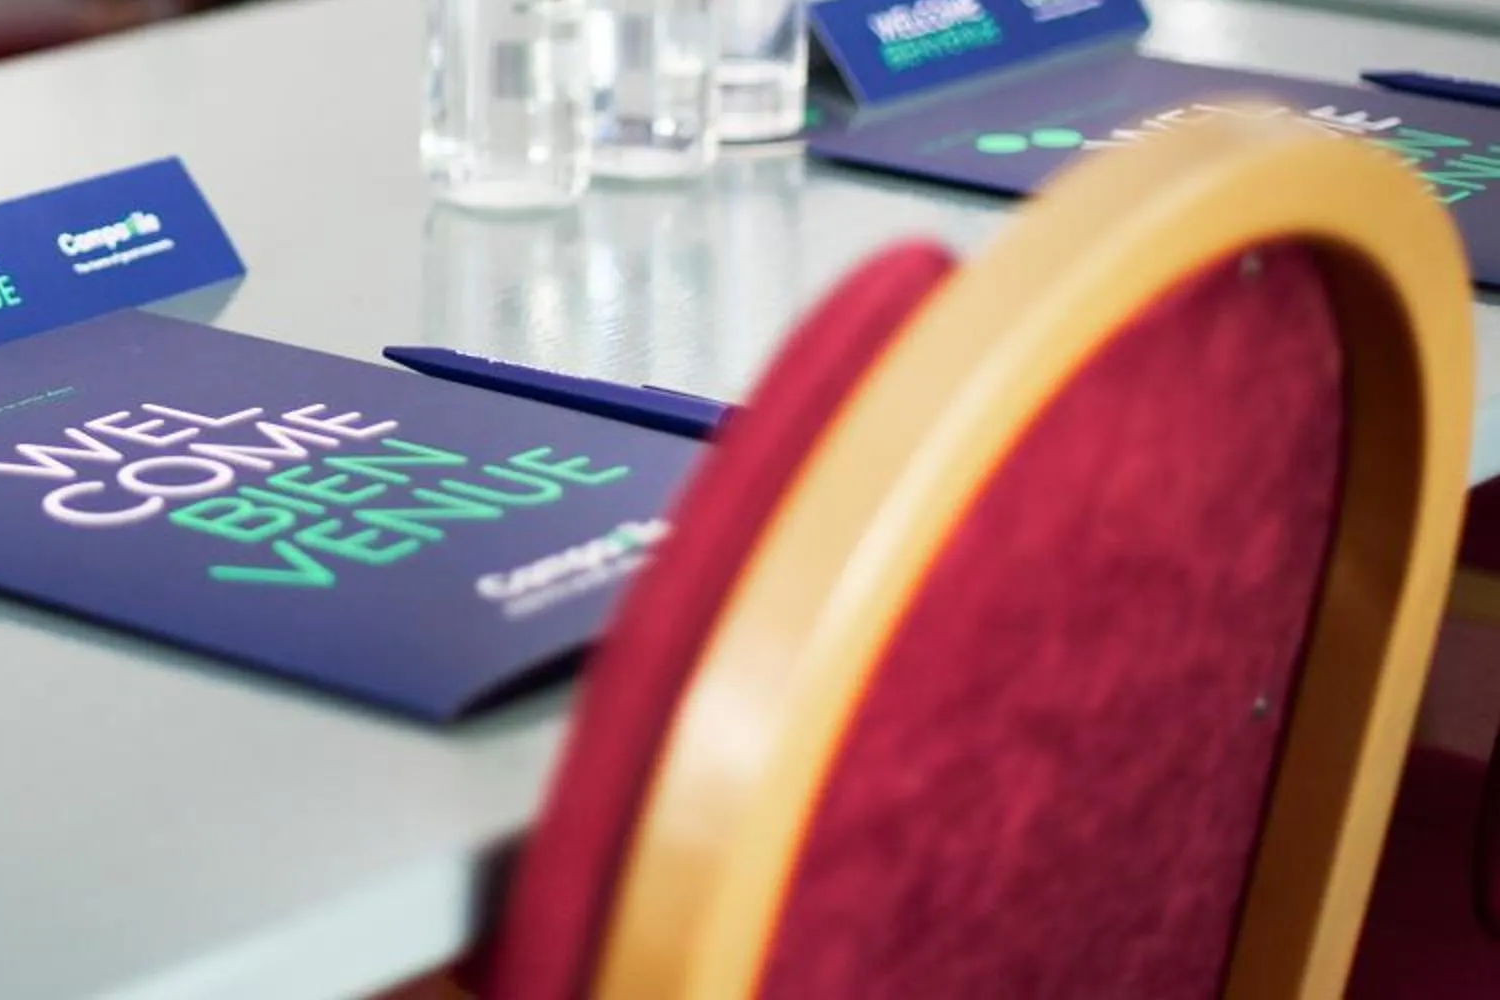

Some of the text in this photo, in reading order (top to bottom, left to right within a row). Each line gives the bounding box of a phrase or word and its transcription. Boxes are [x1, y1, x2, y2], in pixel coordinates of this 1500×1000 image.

[42, 402, 399, 526] COME
[167, 437, 468, 543] BIEN
[207, 446, 631, 588] VENUE
